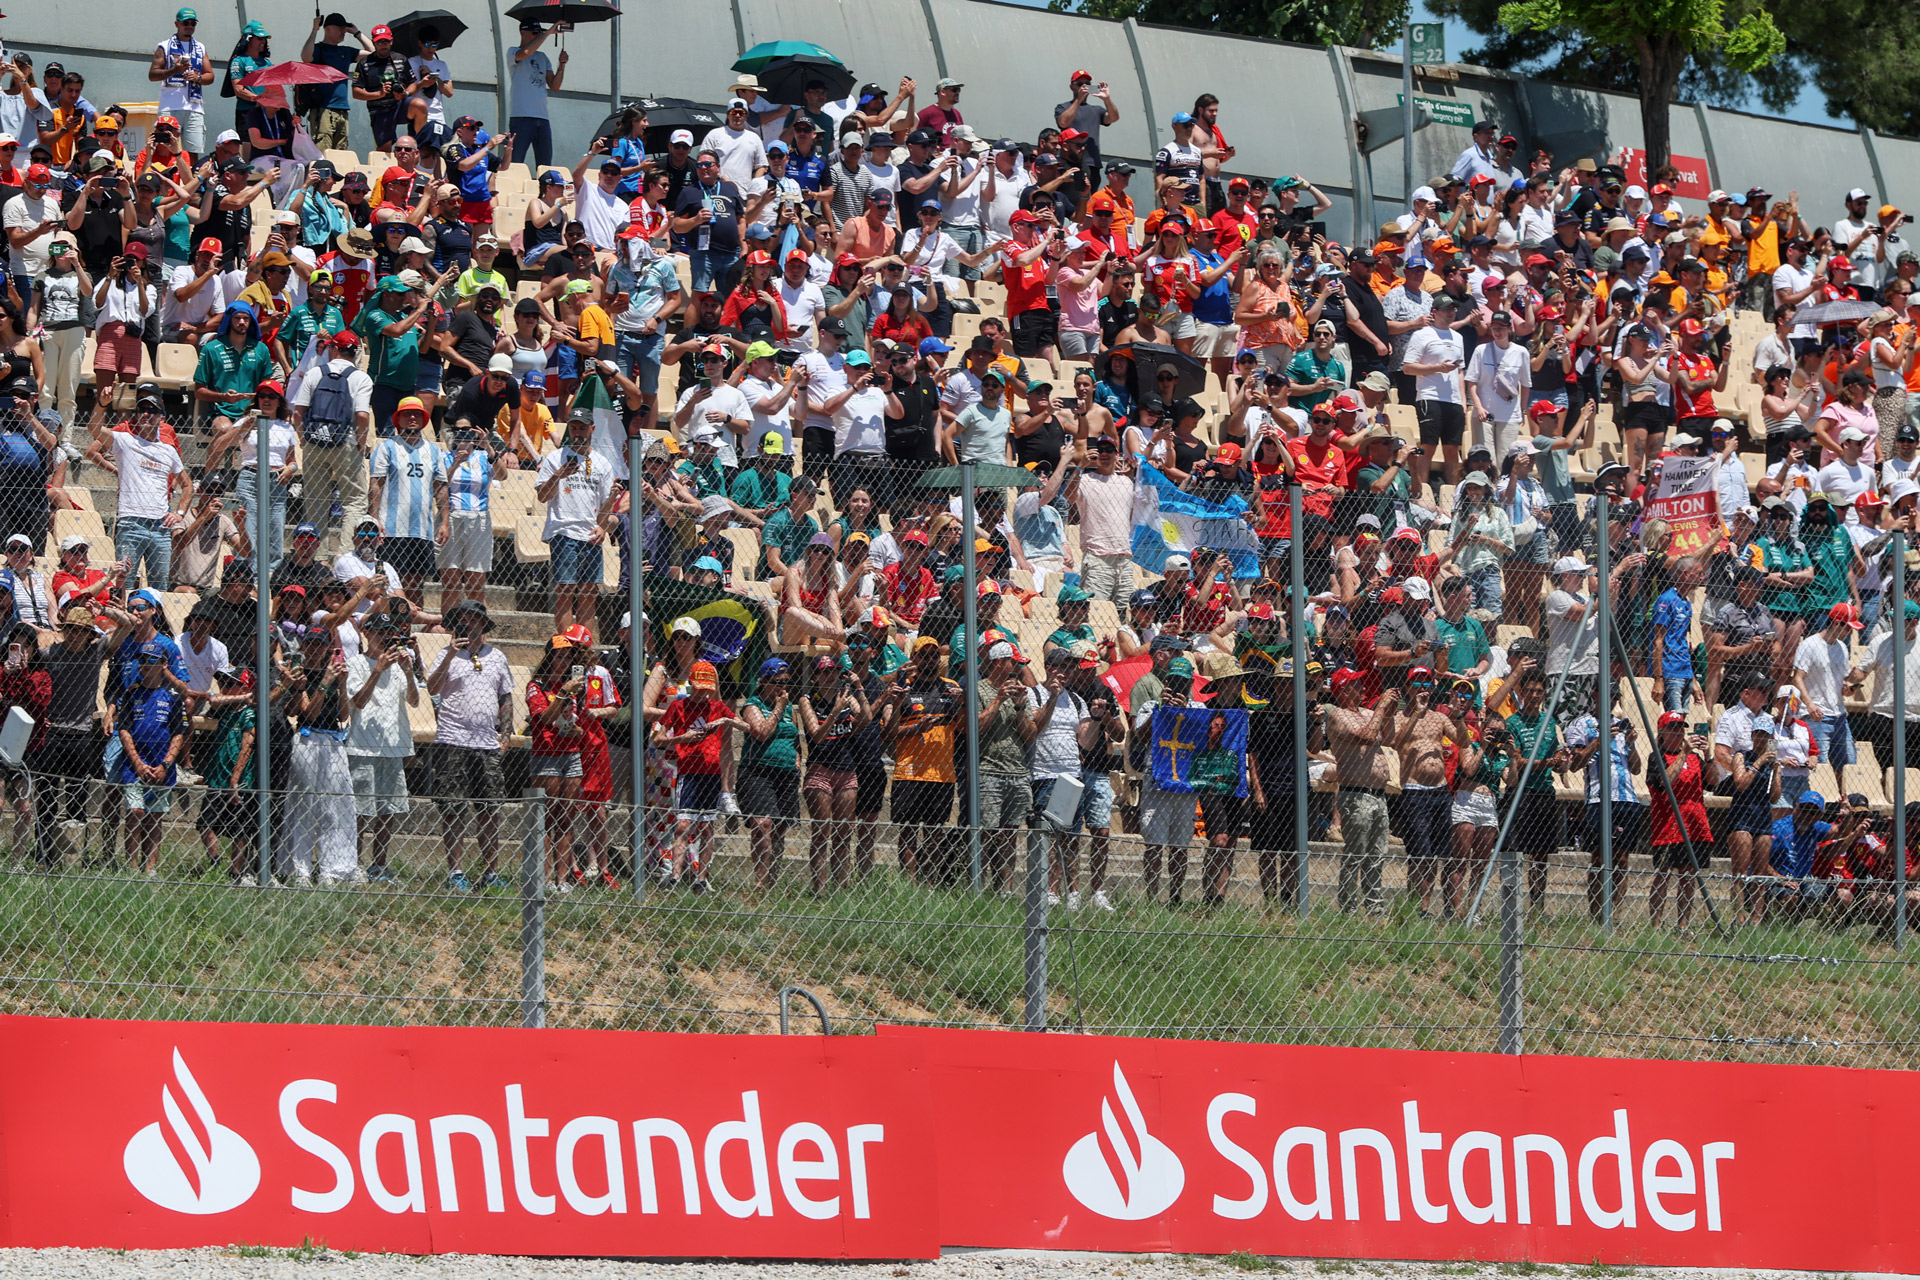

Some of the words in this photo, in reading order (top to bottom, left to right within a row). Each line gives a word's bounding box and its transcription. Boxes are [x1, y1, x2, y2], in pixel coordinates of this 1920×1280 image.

[1412, 25, 1424, 43] G
[1426, 48, 1443, 62] 22
[407, 462, 424, 478] 25
[1680, 459, 1695, 469] ITS
[1664, 468, 1708, 482] HAMMER
[1671, 482, 1694, 494] TIME
[1675, 531, 1702, 550] 44
[279, 1078, 884, 1219] Santander
[1206, 1092, 1735, 1231] Santander
